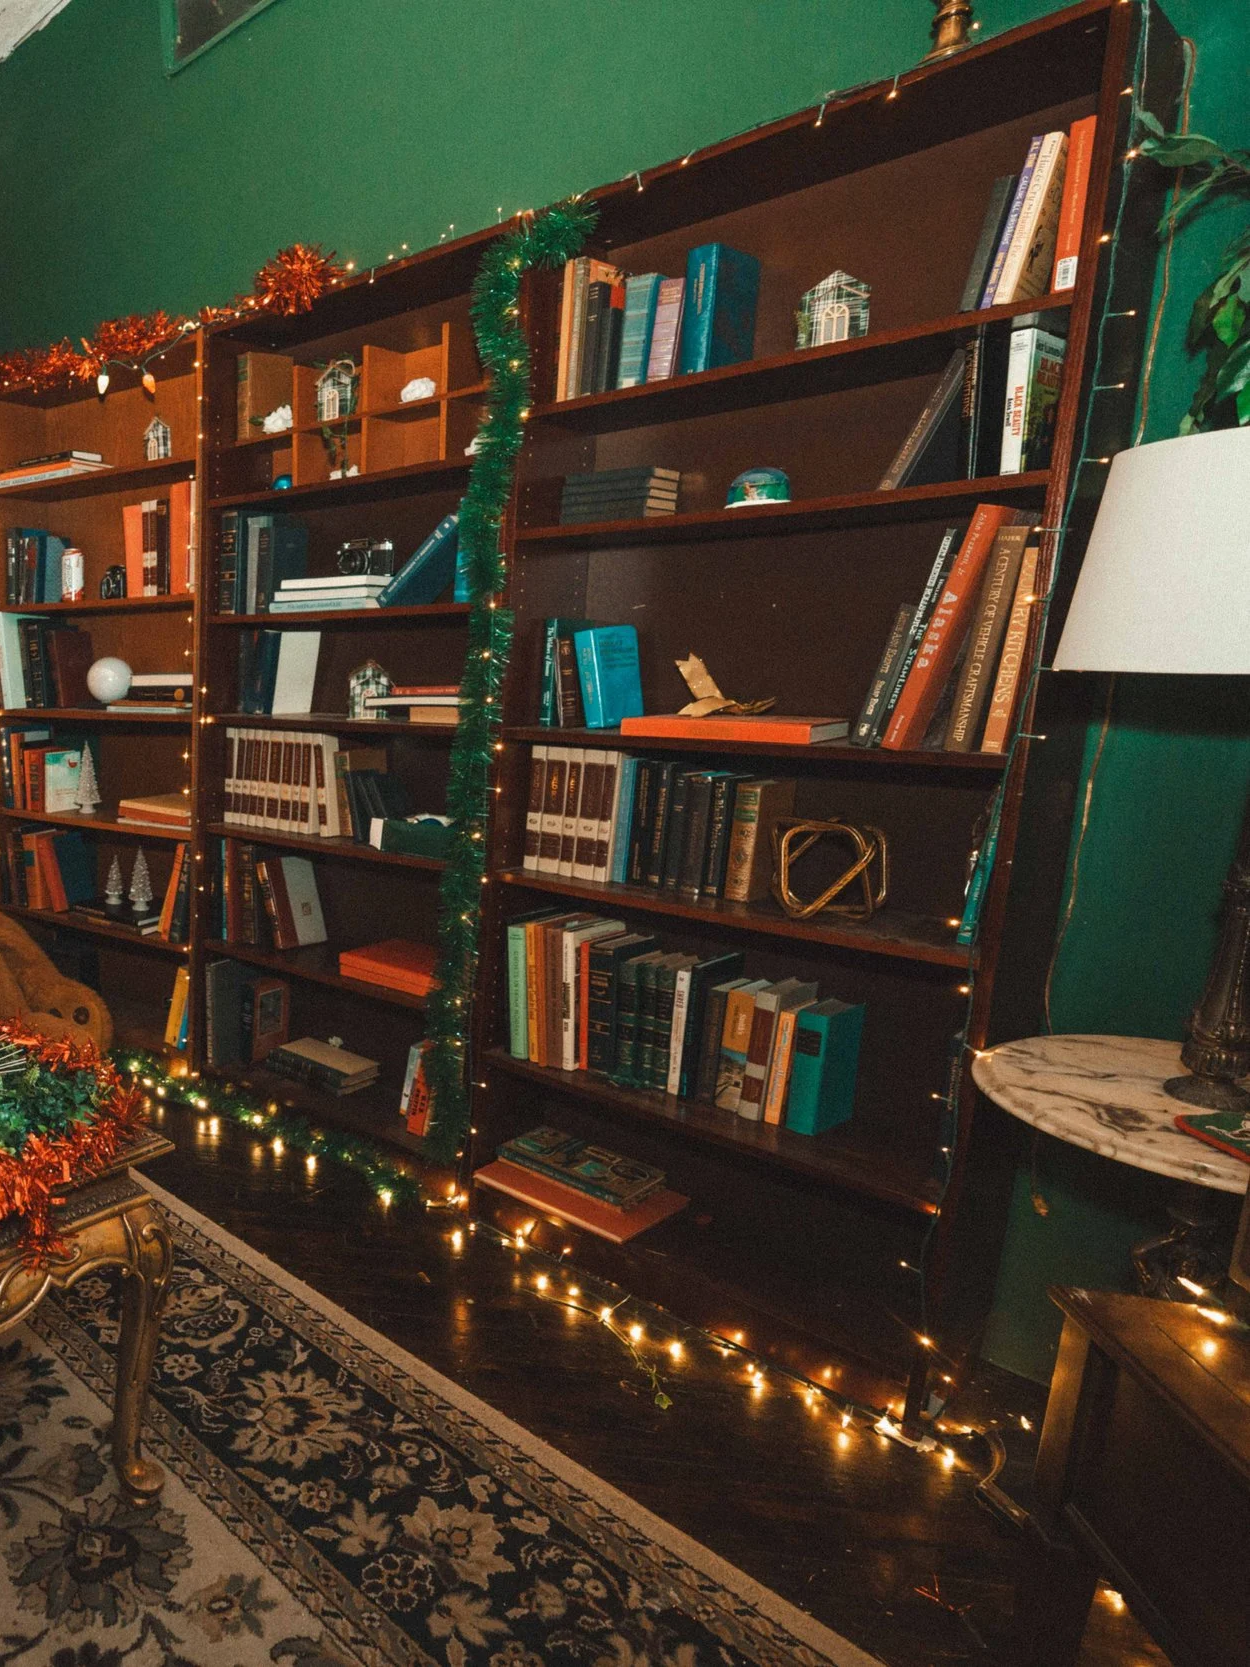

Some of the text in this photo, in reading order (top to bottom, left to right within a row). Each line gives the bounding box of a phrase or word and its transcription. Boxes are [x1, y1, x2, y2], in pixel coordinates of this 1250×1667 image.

[1036, 153, 1051, 175] Hue
[1026, 182, 1042, 202] Cry
[1010, 244, 1021, 258] Pie
[1011, 385, 1024, 436] BLACK BEAUTY
[974, 512, 987, 531] John
[998, 547, 1010, 557] A
[986, 555, 1009, 603] CENTURY
[983, 603, 997, 618] OF
[913, 621, 926, 641] THE
[915, 590, 959, 672] Alaska
[972, 618, 993, 660] VEHICLE
[879, 646, 896, 674] KRENTZ
[994, 629, 1024, 704] KITCHENS
[952, 661, 983, 742] CRAFTSMANSHIP
